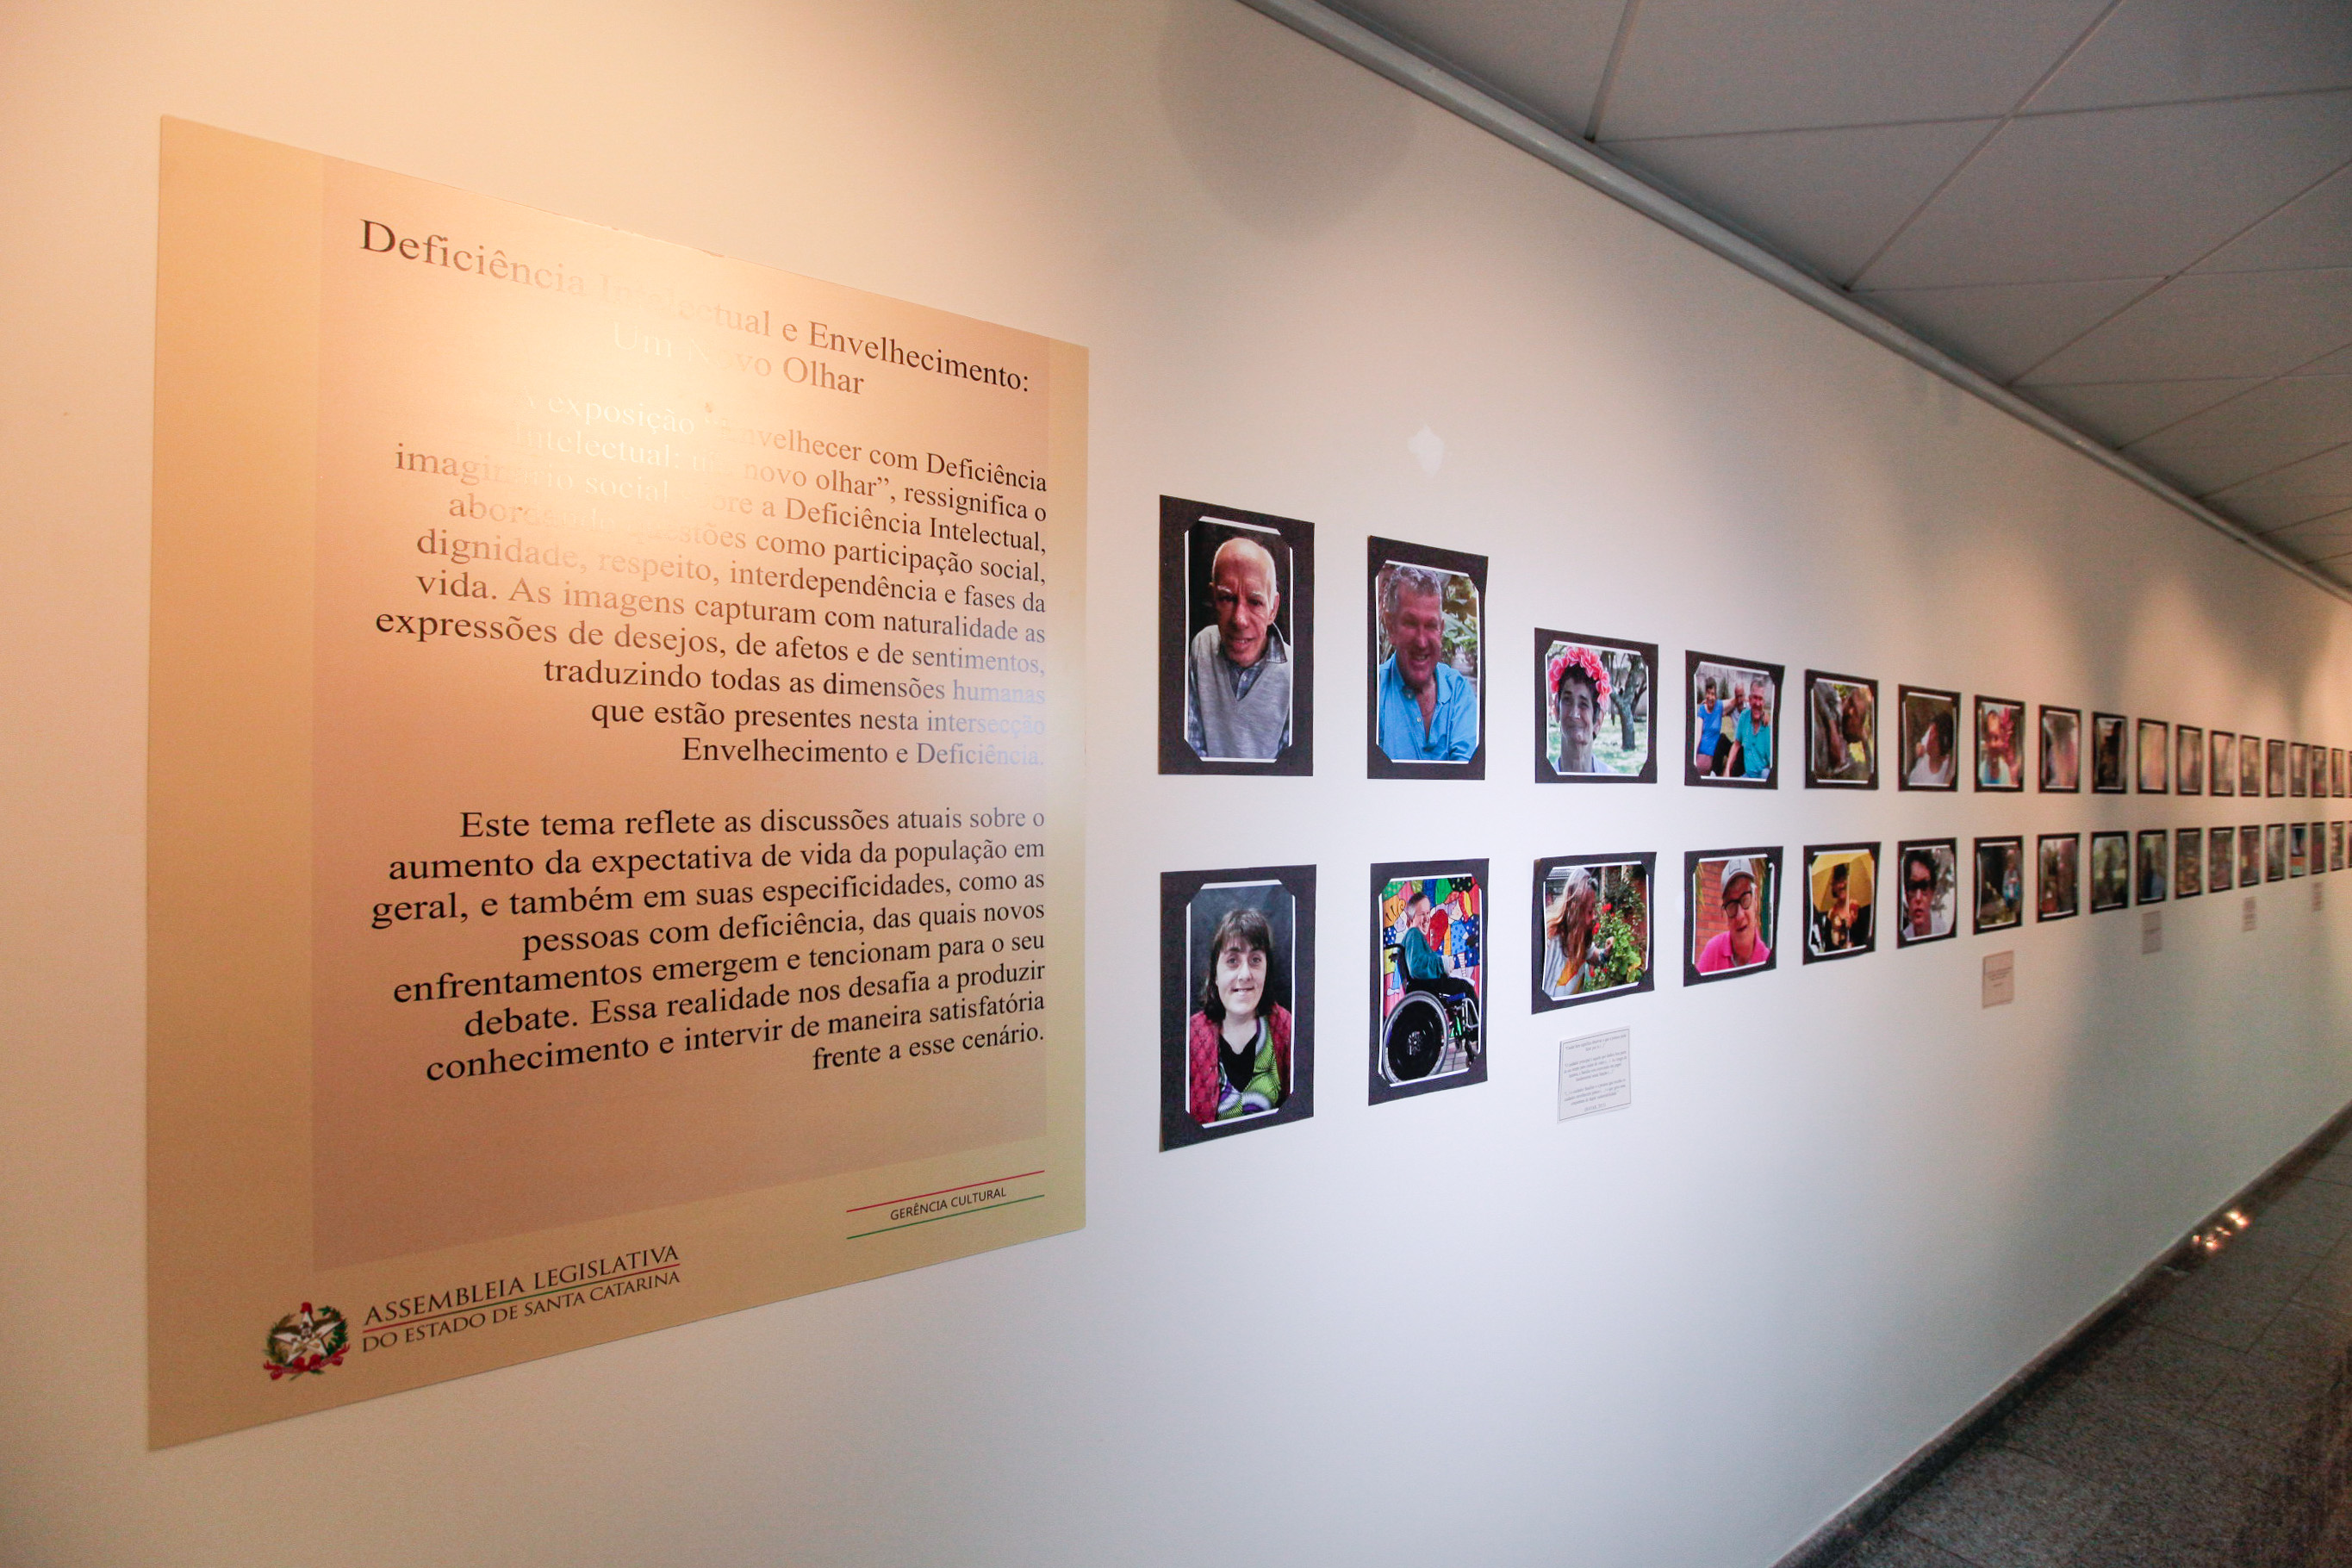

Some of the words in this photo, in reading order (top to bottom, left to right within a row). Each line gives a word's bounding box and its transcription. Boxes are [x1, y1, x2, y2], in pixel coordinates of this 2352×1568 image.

[360, 218, 583, 291] Deficiência
[781, 322, 797, 342] e
[809, 320, 1028, 392] Envelhecimento:
[613, 320, 672, 358] Um
[782, 356, 864, 395] Olhar
[513, 419, 681, 469] Intelectual:
[743, 463, 807, 488] novo
[815, 469, 895, 503] olhar”,
[904, 487, 1027, 519] ressignifica
[1034, 507, 1046, 521] o
[547, 394, 695, 438] exposição
[703, 414, 862, 464] “nvelhecer
[868, 449, 918, 470] com
[926, 451, 1047, 492] Deficiência
[395, 441, 574, 491] imagirio
[584, 475, 670, 504] social
[762, 501, 775, 517] a
[785, 496, 921, 536] Deficiência
[930, 516, 1046, 556] Intelectual,
[415, 527, 587, 573] dignidade,
[598, 553, 719, 585] respeito,
[730, 559, 936, 602] interdependência
[943, 588, 955, 604] e
[964, 584, 1015, 609] fases
[1022, 591, 1045, 613] da
[448, 491, 617, 535] aborndo
[626, 519, 746, 550] stões
[755, 534, 825, 557] como
[834, 542, 973, 576] participação
[980, 558, 1045, 585] social,
[415, 569, 496, 600] vida.
[507, 576, 551, 604] As
[563, 580, 684, 617] imagens
[694, 599, 815, 625] capturam
[824, 610, 874, 629] com
[883, 614, 1017, 641] naturalidade
[1024, 627, 1045, 644] as
[375, 613, 557, 643] expressões
[568, 619, 603, 645] de
[613, 623, 725, 657] desejos,
[736, 632, 766, 656] de
[775, 635, 848, 661] afetos
[856, 646, 868, 663] e
[876, 641, 904, 664] de
[912, 646, 1044, 678] sentimentos,
[543, 658, 700, 688] traduzindo
[711, 667, 780, 692] todas
[789, 676, 814, 694] as
[823, 671, 945, 700] dimensões
[953, 679, 1045, 704] humanas
[591, 704, 644, 728] que
[654, 701, 725, 725] estão
[734, 709, 850, 732] presentes
[859, 712, 918, 731] nesta
[681, 737, 887, 763] Envelhecimento
[895, 748, 908, 763] e
[916, 742, 1043, 765] Deficiência.
[389, 854, 533, 880] aumento
[544, 849, 581, 874] da
[591, 844, 752, 878] expectativa
[761, 843, 791, 867] de
[800, 842, 851, 865] vida
[859, 841, 887, 863] da
[894, 838, 1007, 868] população
[1013, 843, 1044, 858] em
[459, 812, 529, 837] Este
[540, 814, 614, 836] tema
[625, 809, 715, 834] reflete
[724, 815, 750, 832] as
[760, 807, 889, 831] discussões
[897, 806, 961, 829] atuais
[969, 806, 1025, 828] sobre
[1032, 812, 1044, 827] o
[370, 891, 468, 928] geral,
[481, 898, 497, 917] e
[508, 886, 632, 915] também
[643, 889, 685, 908] em
[696, 887, 753, 905] suas
[762, 872, 950, 906] especificidades,
[958, 874, 1017, 892] como
[1024, 873, 1044, 888] as
[522, 929, 638, 961] pessoas
[649, 924, 709, 944] com
[719, 909, 863, 940] deficiência,
[873, 906, 911, 930] das
[918, 902, 976, 931] quais
[983, 904, 1044, 922] novos
[393, 964, 642, 1003] enfrentamentos
[652, 955, 777, 981] emergem
[787, 953, 800, 970] e
[808, 941, 930, 968] tencionam
[938, 939, 984, 963] para
[991, 937, 1004, 952] o
[1011, 934, 1044, 950] seu
[464, 1006, 577, 1037] debate.
[591, 999, 656, 1024] Essa
[666, 983, 789, 1017] realidade
[799, 984, 840, 1003] nos
[848, 970, 930, 998] desafia
[936, 974, 949, 989] a
[956, 959, 1045, 993] produzir
[426, 1037, 649, 1081] conhecimento
[658, 1036, 674, 1054] e
[684, 1017, 783, 1051] intervir
[790, 1014, 819, 1038] de
[827, 1004, 921, 1034] maneira
[929, 990, 1045, 1023] satisfatória
[812, 1045, 880, 1070] frente
[888, 1043, 901, 1060] a
[908, 1036, 955, 1057] esse
[961, 1022, 1043, 1050] cenário.
[890, 1200, 948, 1220] GERÊNCIA
[950, 1187, 1006, 1207] CULTURAL
[362, 1332, 397, 1353] DO
[405, 1313, 486, 1343] ESTADO
[493, 1305, 518, 1323] DE
[525, 1291, 585, 1316] SANTA
[589, 1271, 681, 1301] CATARINA
[364, 1276, 525, 1326] ASSEMBLEIA
[534, 1245, 679, 1290] LEGISLATIVA
